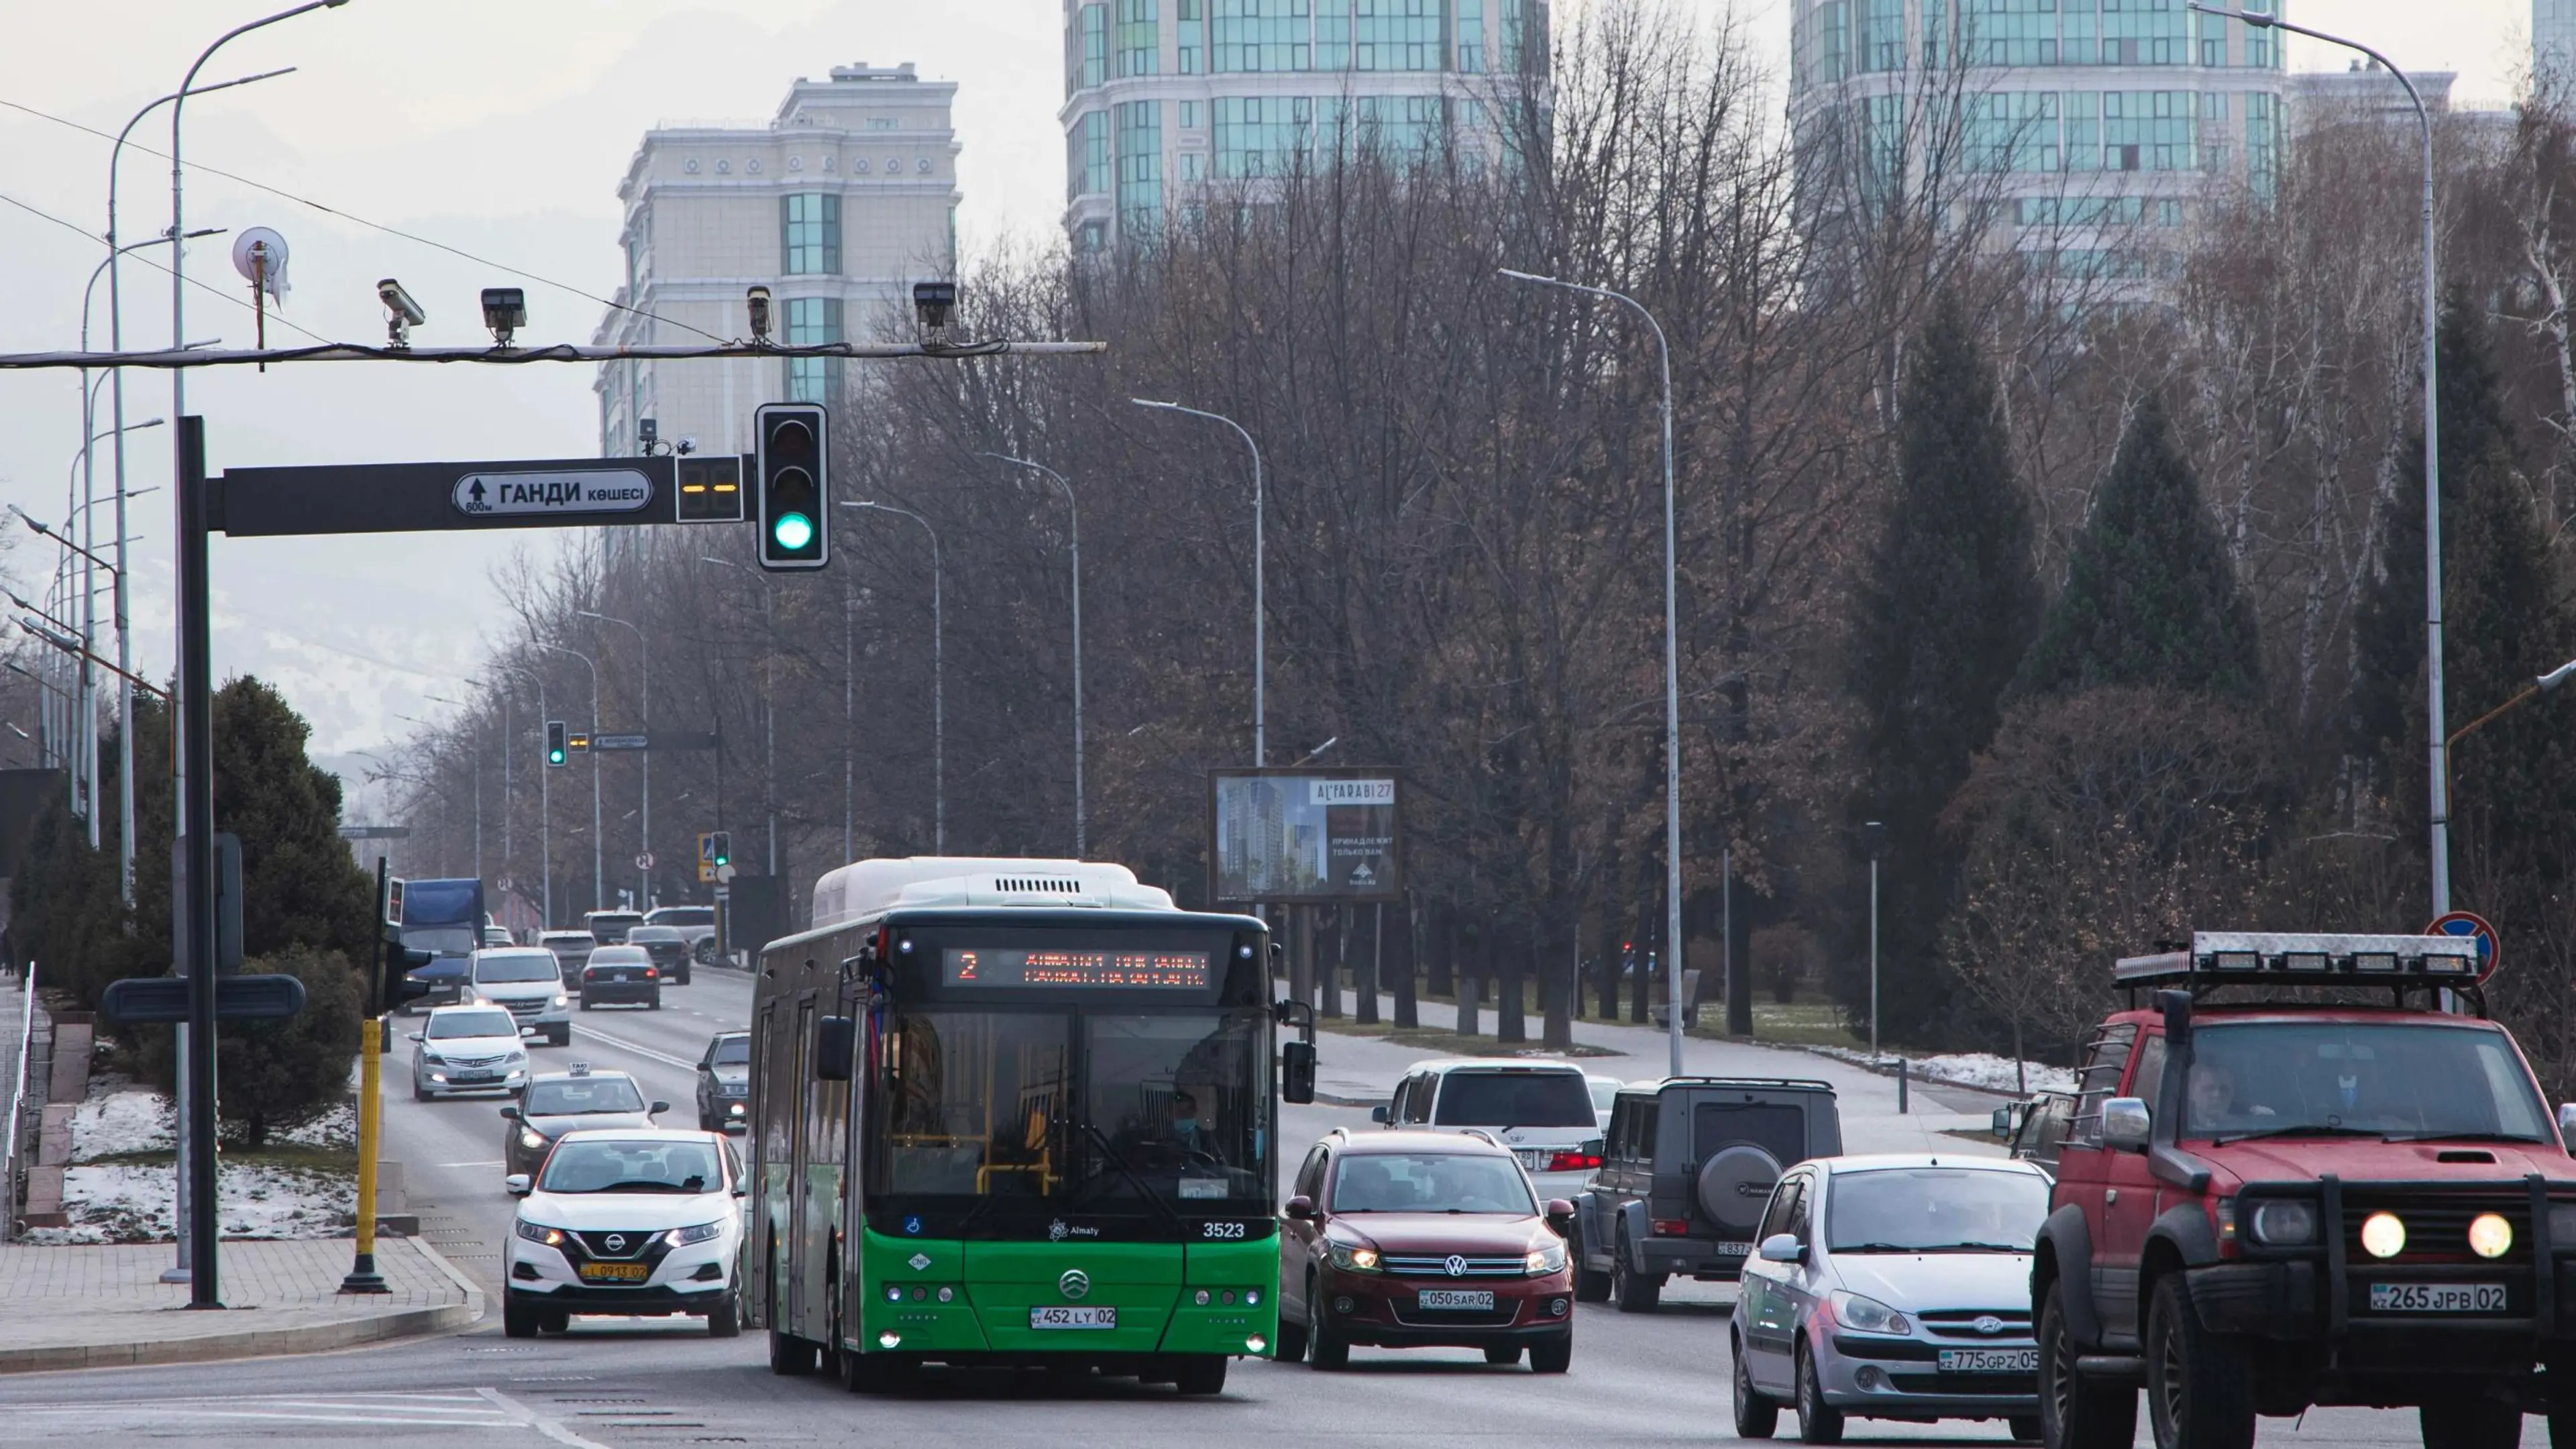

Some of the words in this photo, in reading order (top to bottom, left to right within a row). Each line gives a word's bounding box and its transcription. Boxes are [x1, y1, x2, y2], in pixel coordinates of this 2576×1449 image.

[500, 482, 580, 506] ГАНДИ
[1332, 837, 1393, 846] ПРИНАДЛЕЖИТ
[1333, 848, 1363, 856] ТОЛЬКО
[1365, 848, 1383, 856] ВАМ
[959, 951, 977, 978] 2
[1070, 1226, 1099, 1236] Almaty
[1203, 1223, 1244, 1238] 3523
[1478, 1293, 1493, 1305] 02
[2389, 1287, 2430, 1309] 265
[2478, 1288, 2504, 1309] 02
[1043, 1309, 1070, 1324] 452
[1075, 1311, 1091, 1323] LY
[1097, 1310, 1115, 1324] 02
[2020, 1352, 2039, 1368] 05
